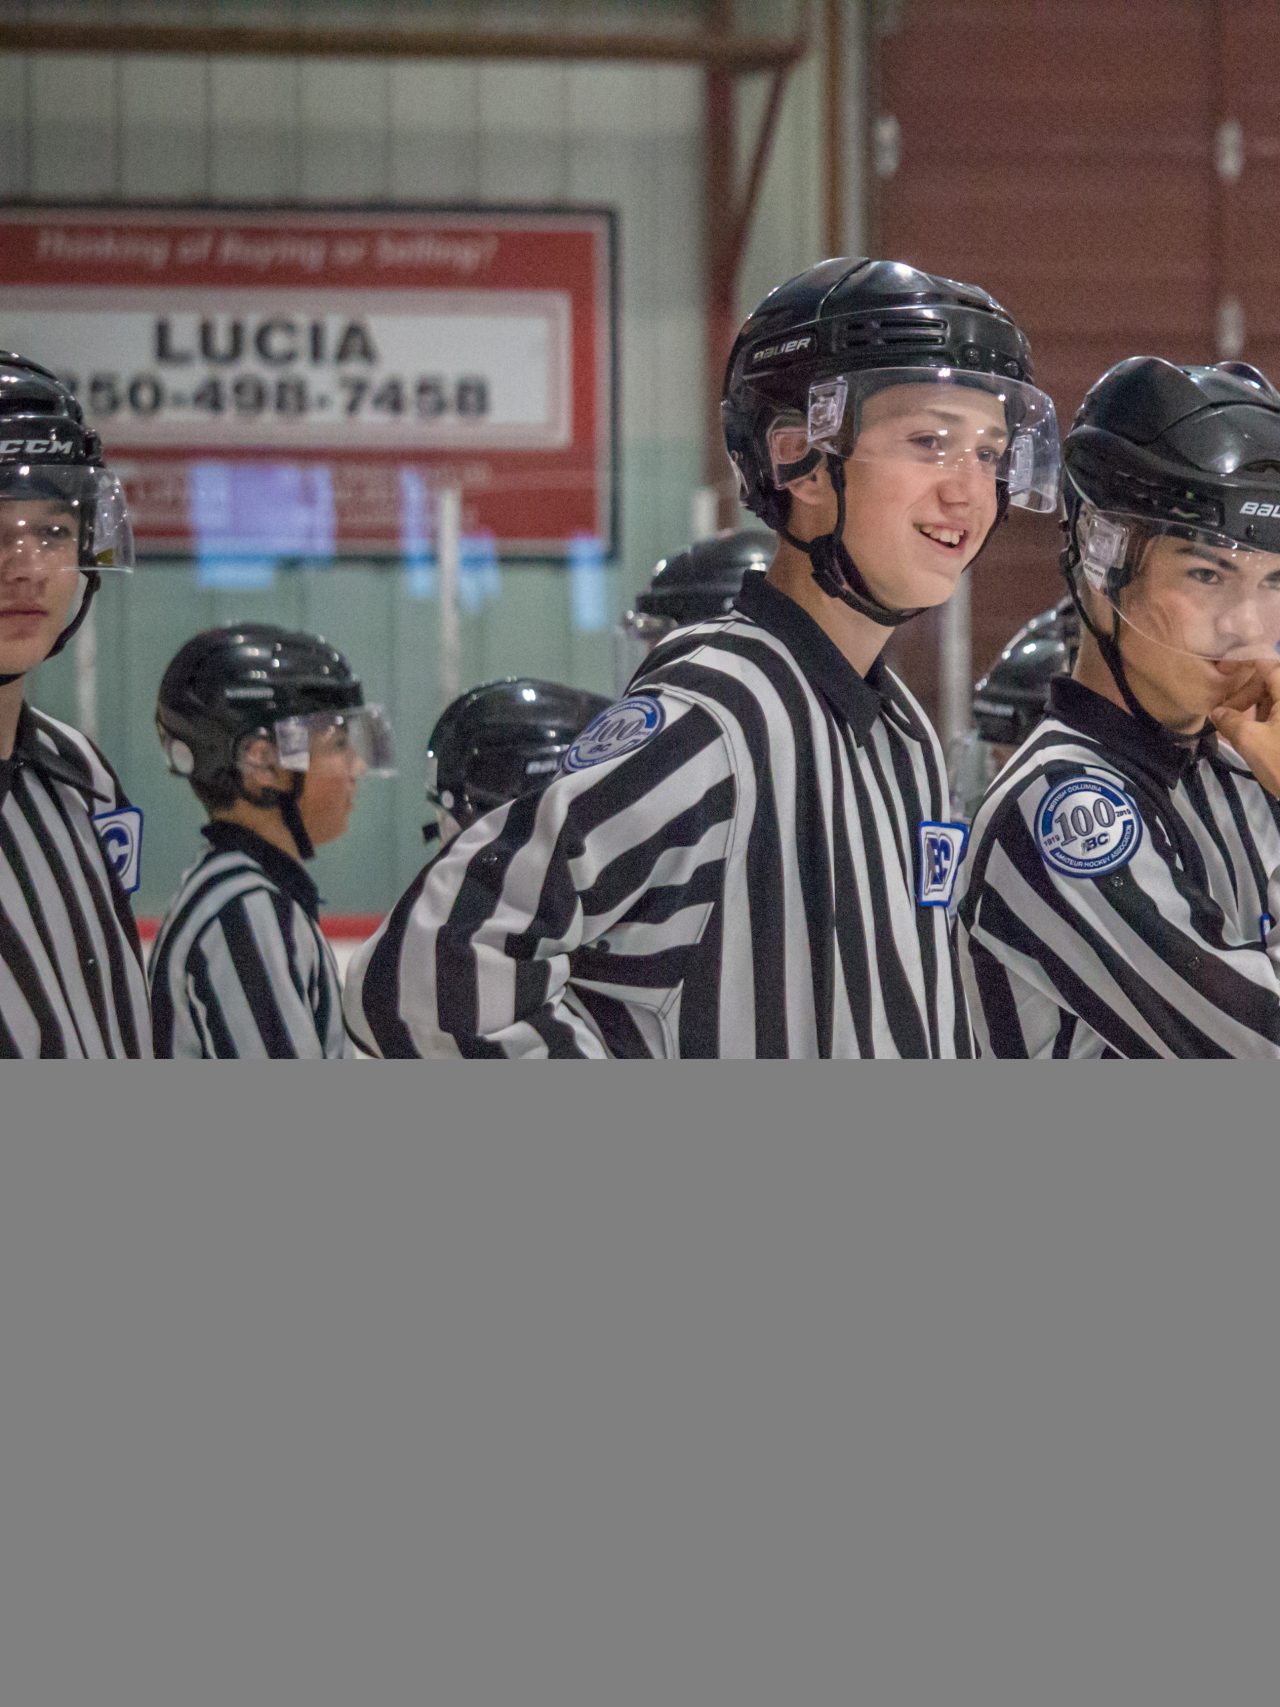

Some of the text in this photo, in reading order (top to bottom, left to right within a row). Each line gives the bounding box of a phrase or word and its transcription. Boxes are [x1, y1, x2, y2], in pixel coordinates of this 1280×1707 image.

[154, 316, 379, 366] LUCIA
[0, 439, 74, 454] CCM
[1055, 797, 1116, 847] 100
[1083, 832, 1109, 852] BC
